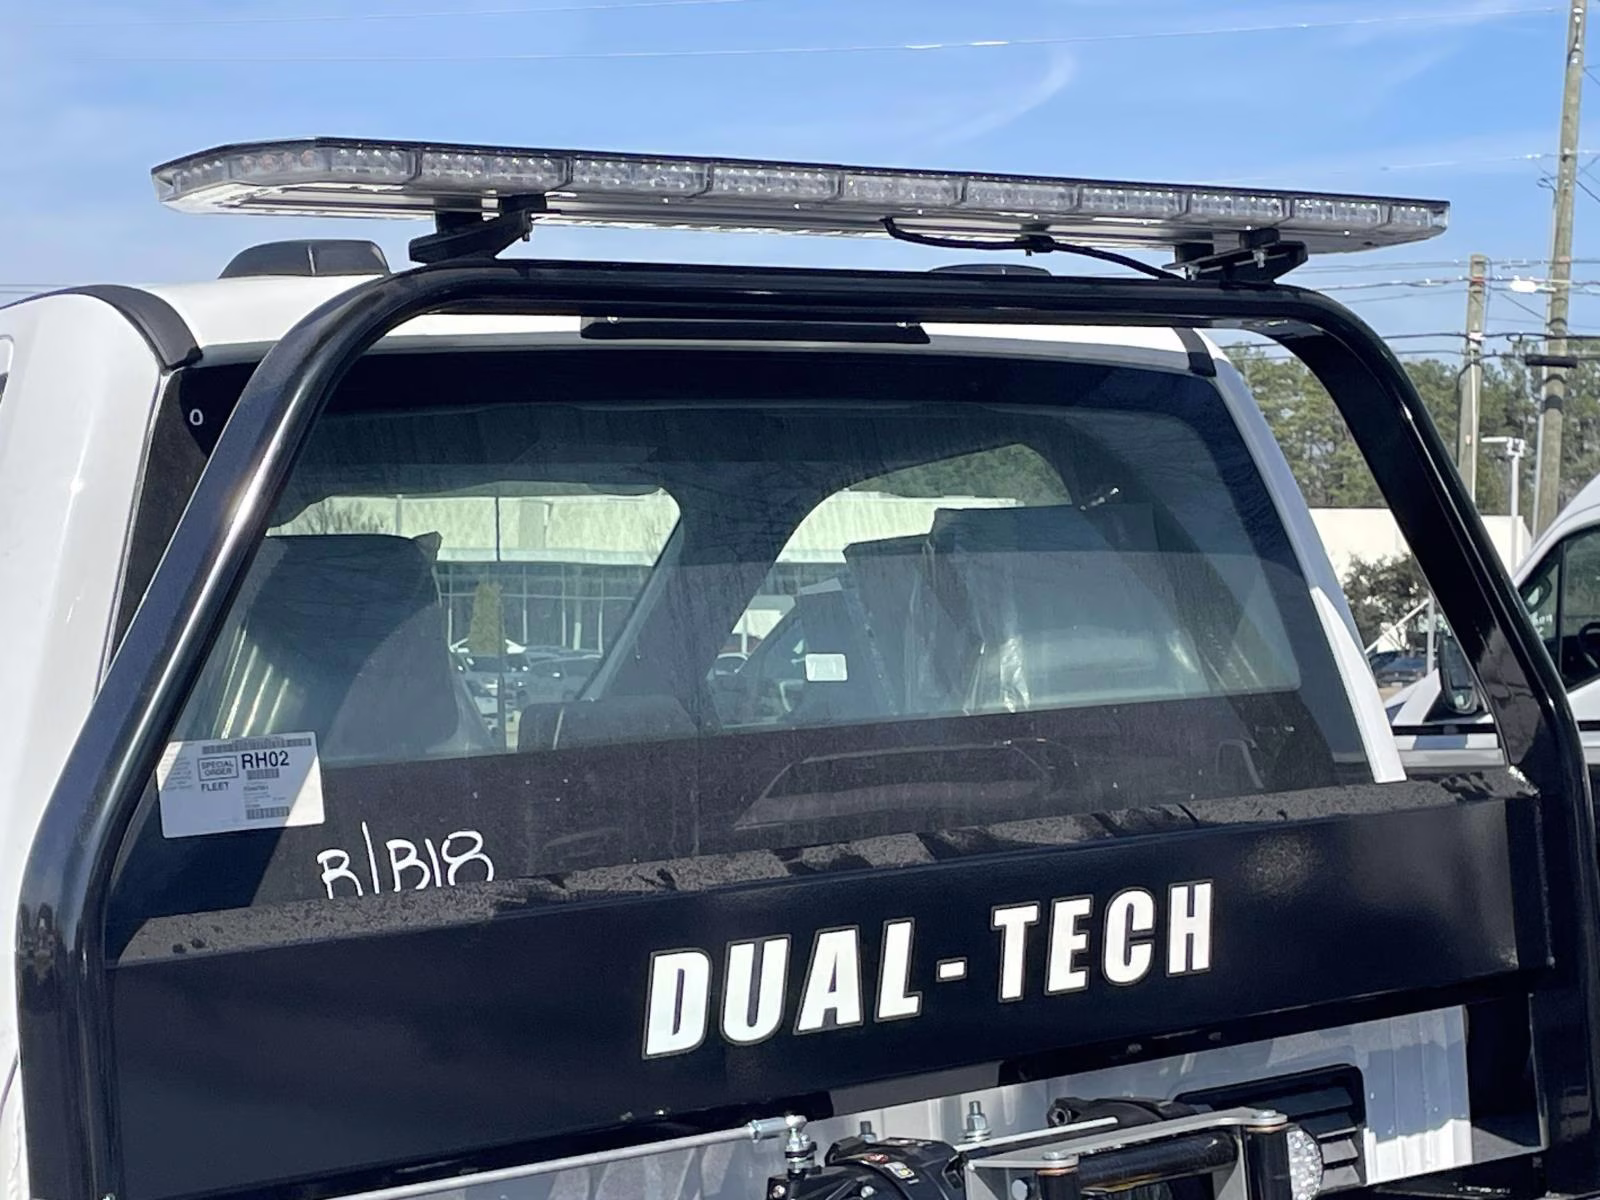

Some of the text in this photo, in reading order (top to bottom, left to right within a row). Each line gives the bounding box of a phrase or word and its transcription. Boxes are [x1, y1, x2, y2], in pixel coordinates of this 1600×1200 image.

[201, 760, 234, 770] SPECIAL
[241, 750, 290, 770] RH02
[204, 768, 232, 777] ORDER
[201, 782, 229, 792] FLEET
[991, 879, 1214, 1004] TECH
